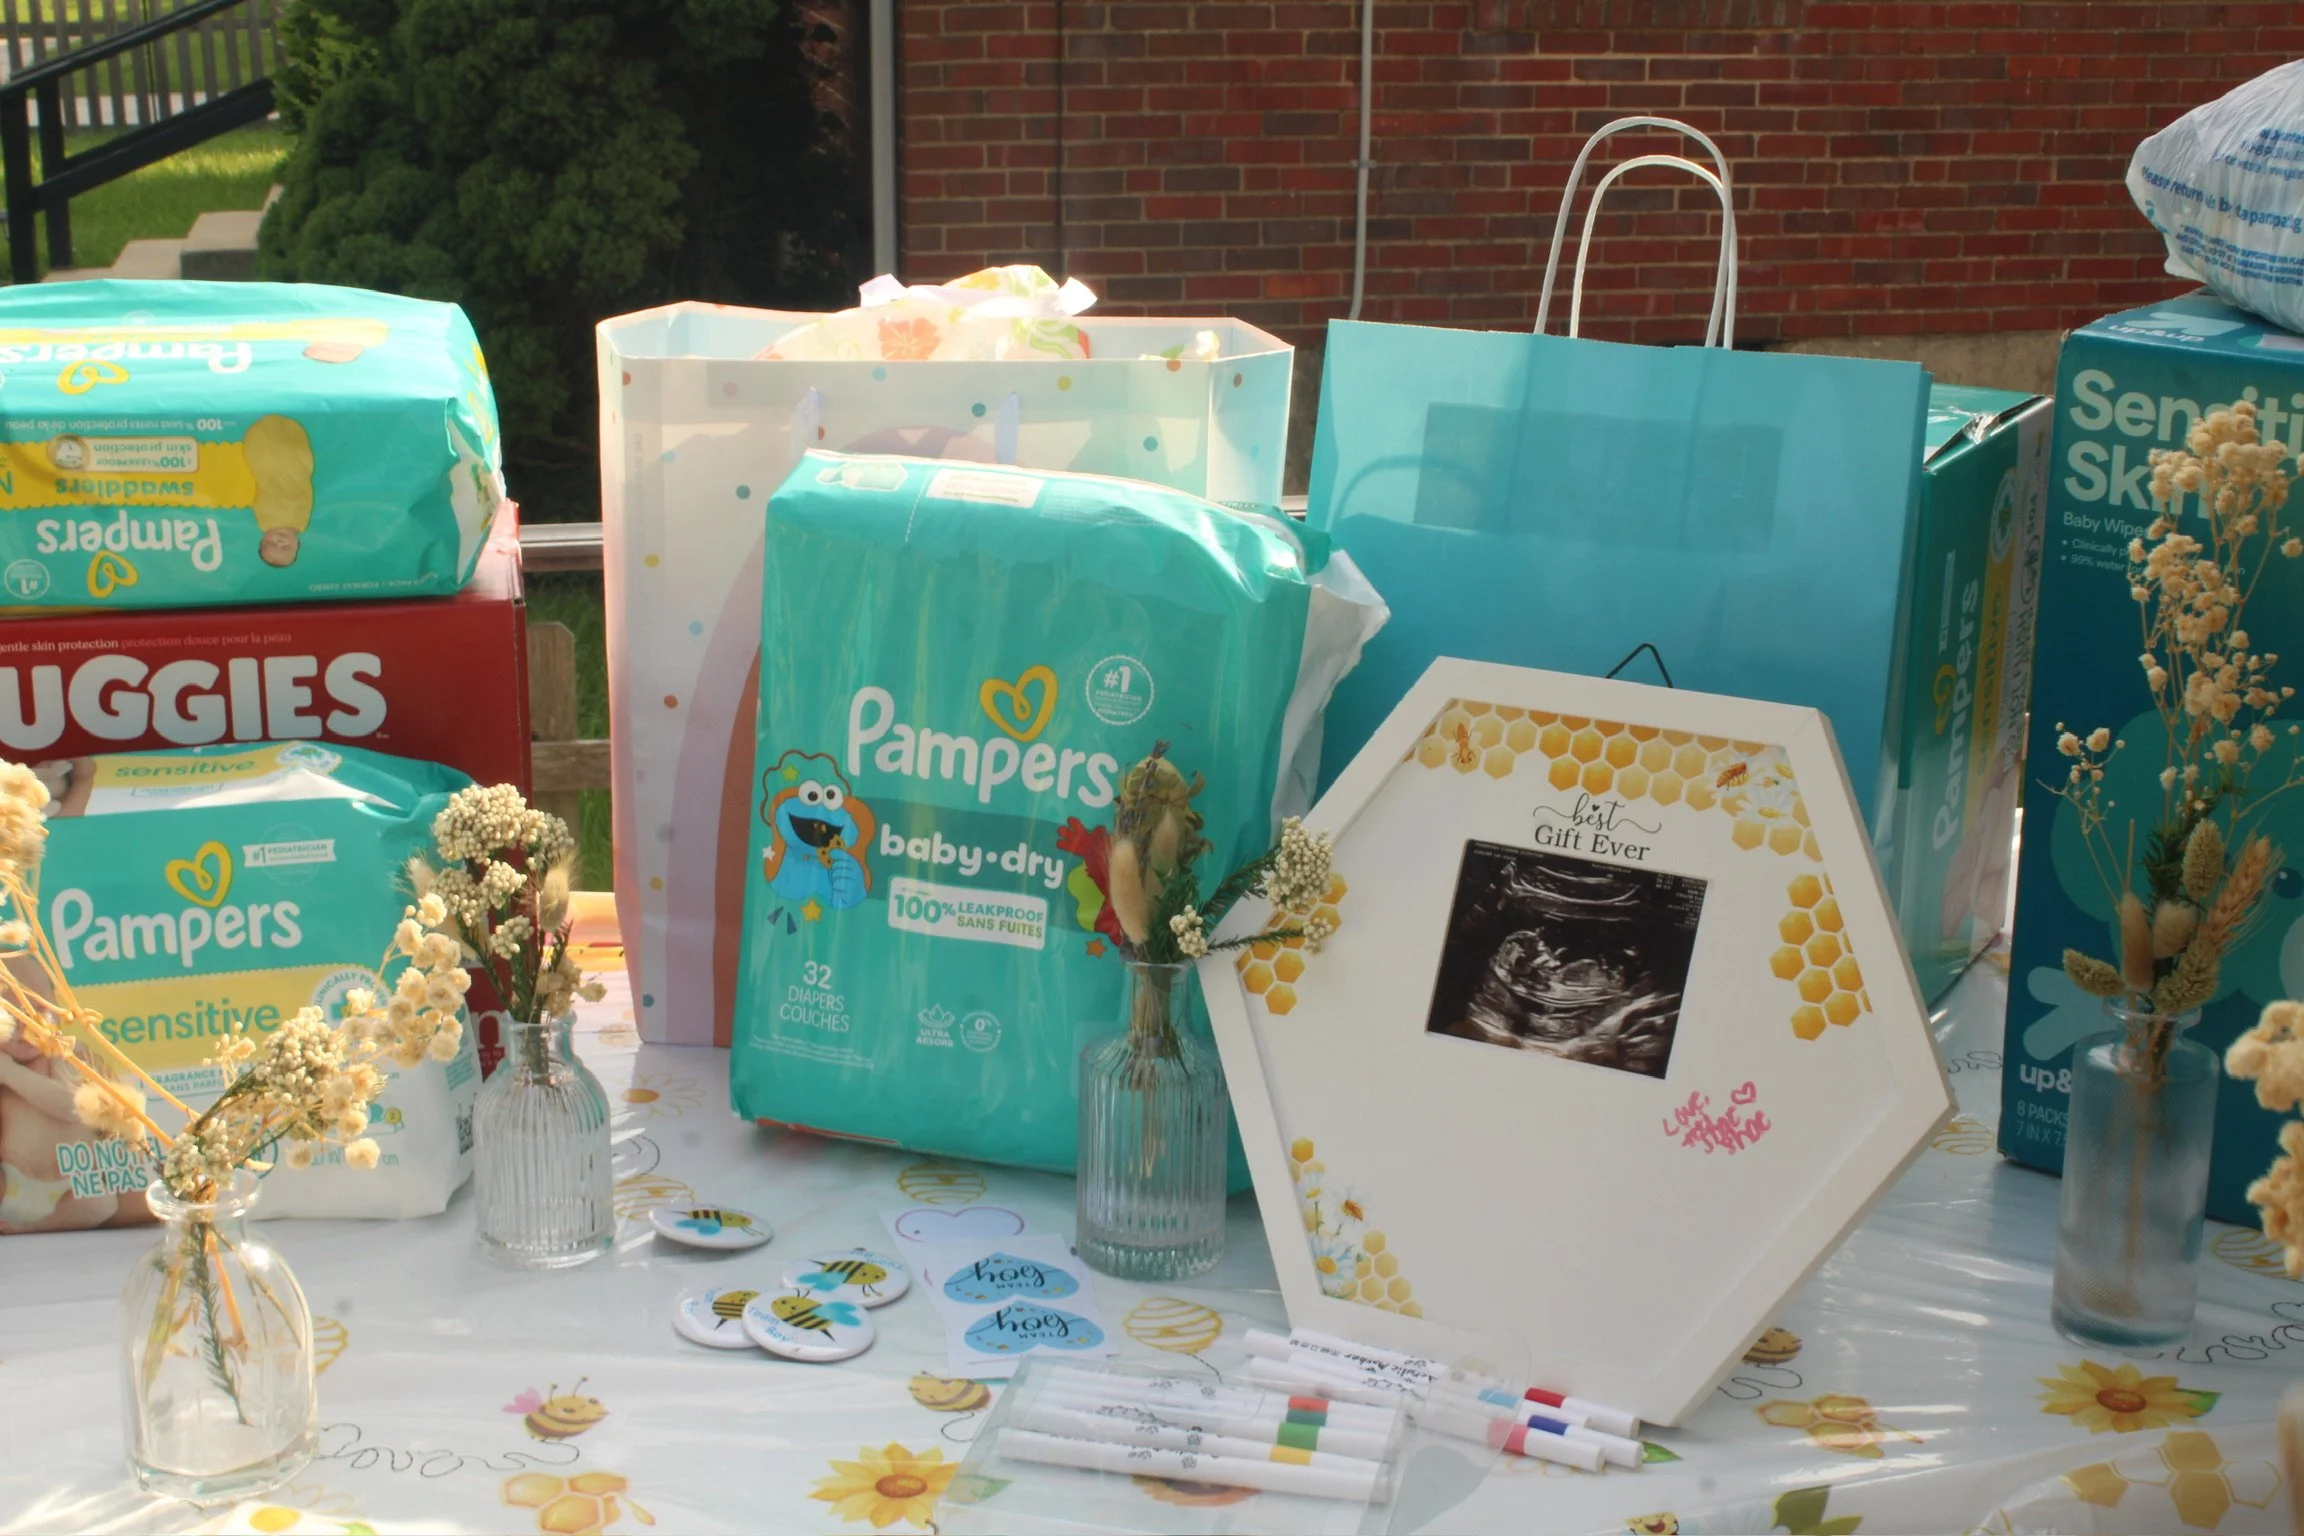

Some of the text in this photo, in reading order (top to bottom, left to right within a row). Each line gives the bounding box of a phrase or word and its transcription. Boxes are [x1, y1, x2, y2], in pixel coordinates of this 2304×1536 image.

[93, 442, 163, 453] protection
[55, 478, 194, 498] swaddlers
[2063, 511, 2144, 538] Baby Wipe
[37, 509, 223, 572] Pampers
[2071, 538, 2117, 556] Clinically
[2070, 553, 2094, 567] 99%
[2096, 560, 2124, 572] water
[32, 639, 56, 651] skin
[58, 638, 119, 651] protection
[121, 636, 181, 649] protection
[184, 634, 220, 647] douce
[222, 634, 249, 647] pour
[251, 632, 261, 643] la
[264, 632, 292, 645] peau
[1104, 665, 1131, 693] #1
[1932, 576, 1978, 852] Pampers
[848, 685, 1119, 808] Pampers
[115, 760, 255, 778] sensitive
[1549, 793, 1646, 834] best
[252, 846, 266, 864] #1
[1534, 824, 1651, 861] Gift Ever
[894, 894, 1044, 924] 100% LEAKPROOF
[51, 888, 303, 968] Pampers
[957, 915, 1043, 939] SANS FUITES
[803, 960, 832, 989] 32
[788, 985, 845, 1012] DIAPERS
[101, 997, 281, 1045] sensitive
[780, 1003, 850, 1033] COUCHES
[916, 1036, 955, 1049] ABSORB
[920, 1028, 951, 1039] ULTRA
[2016, 1100, 2069, 1129] 8 PACKS
[2016, 1118, 2025, 1136] 7
[2026, 1122, 2040, 1141] IN
[2041, 1127, 2051, 1145] X
[57, 1142, 91, 1173] DO
[72, 1166, 149, 1197] NE PAS
[964, 1258, 1053, 1288] boy
[986, 1305, 1077, 1338] boy
